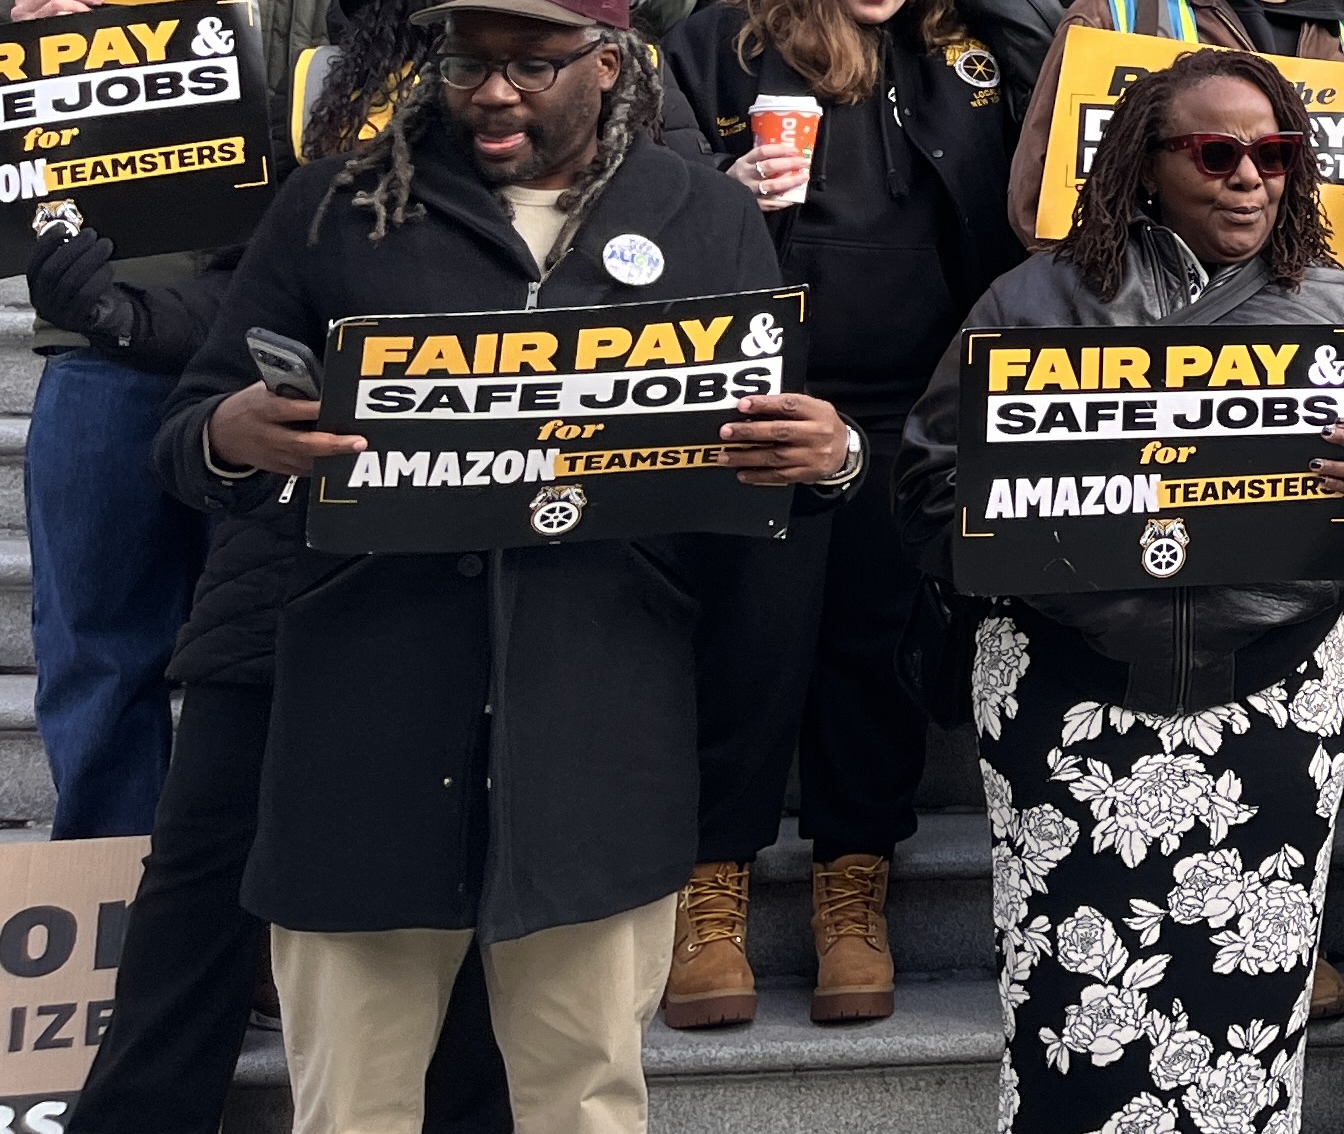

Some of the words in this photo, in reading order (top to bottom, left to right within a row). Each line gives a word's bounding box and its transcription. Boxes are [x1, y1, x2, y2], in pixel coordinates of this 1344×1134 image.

[39, 19, 180, 77] PAY
[190, 16, 236, 58] &
[52, 66, 230, 119] JOBS
[1294, 80, 1337, 106] he
[23, 126, 80, 152] for
[51, 141, 238, 186] TEAMSTERS
[360, 332, 558, 377] FAIR
[575, 315, 734, 372] PAY
[741, 312, 784, 358] &
[365, 381, 561, 416] SAFE
[579, 362, 772, 411] JOBS
[988, 346, 1152, 392] FAIR
[1165, 344, 1300, 388] PAY
[537, 419, 604, 442] for
[996, 400, 1157, 435] SAFE
[1173, 394, 1340, 432] JOBS
[348, 448, 559, 488] AMAZON
[563, 445, 724, 473] TEAMSTE
[1139, 441, 1198, 465] for
[985, 473, 1162, 520] AMAZON
